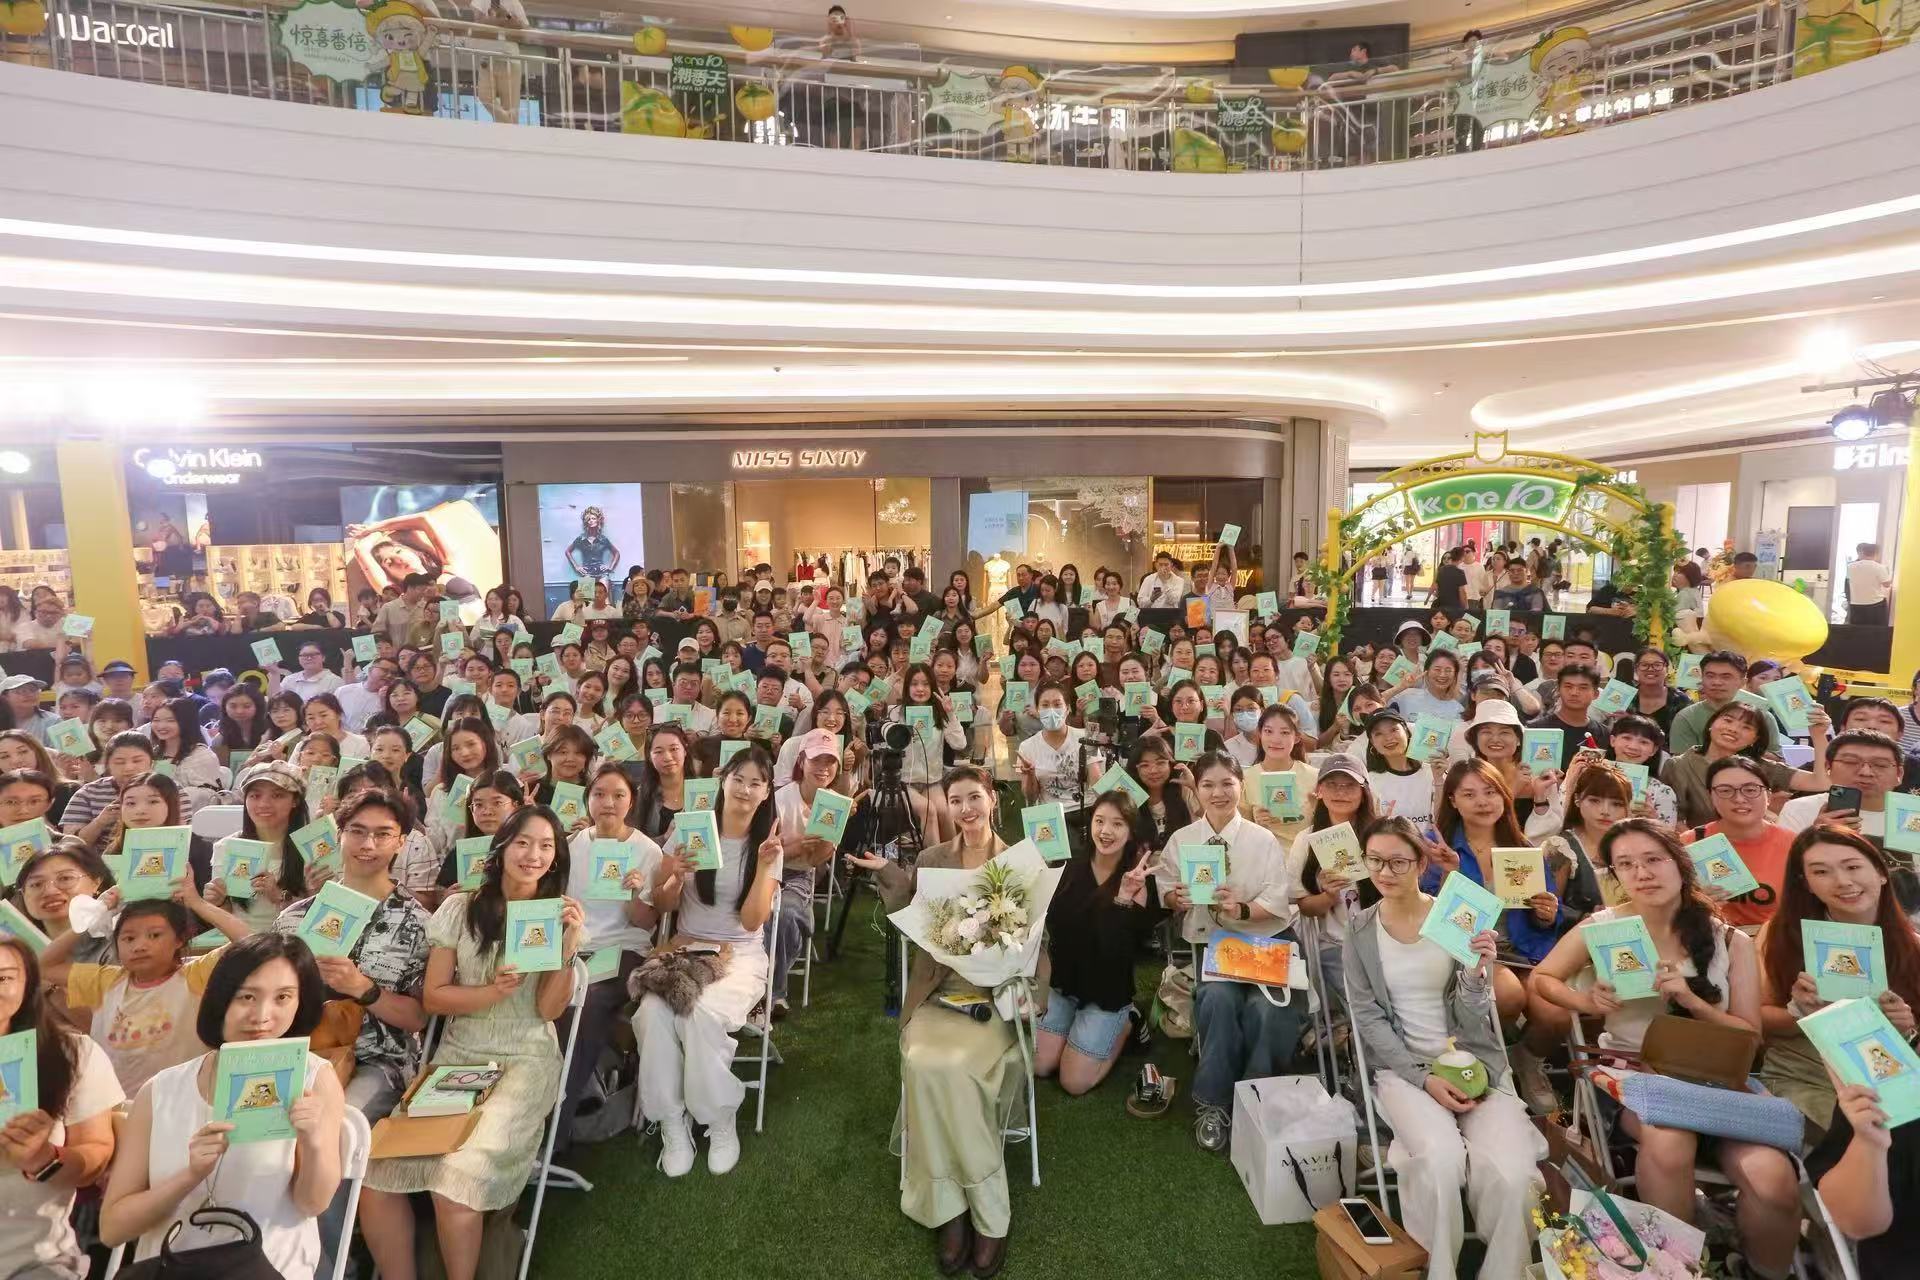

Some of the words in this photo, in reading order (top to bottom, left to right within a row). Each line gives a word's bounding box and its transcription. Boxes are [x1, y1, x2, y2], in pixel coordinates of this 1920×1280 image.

[45, 12, 175, 48] Wacoal
[209, 447, 263, 468] Klein
[732, 450, 793, 467] MISS
[799, 449, 867, 467] SIXTY
